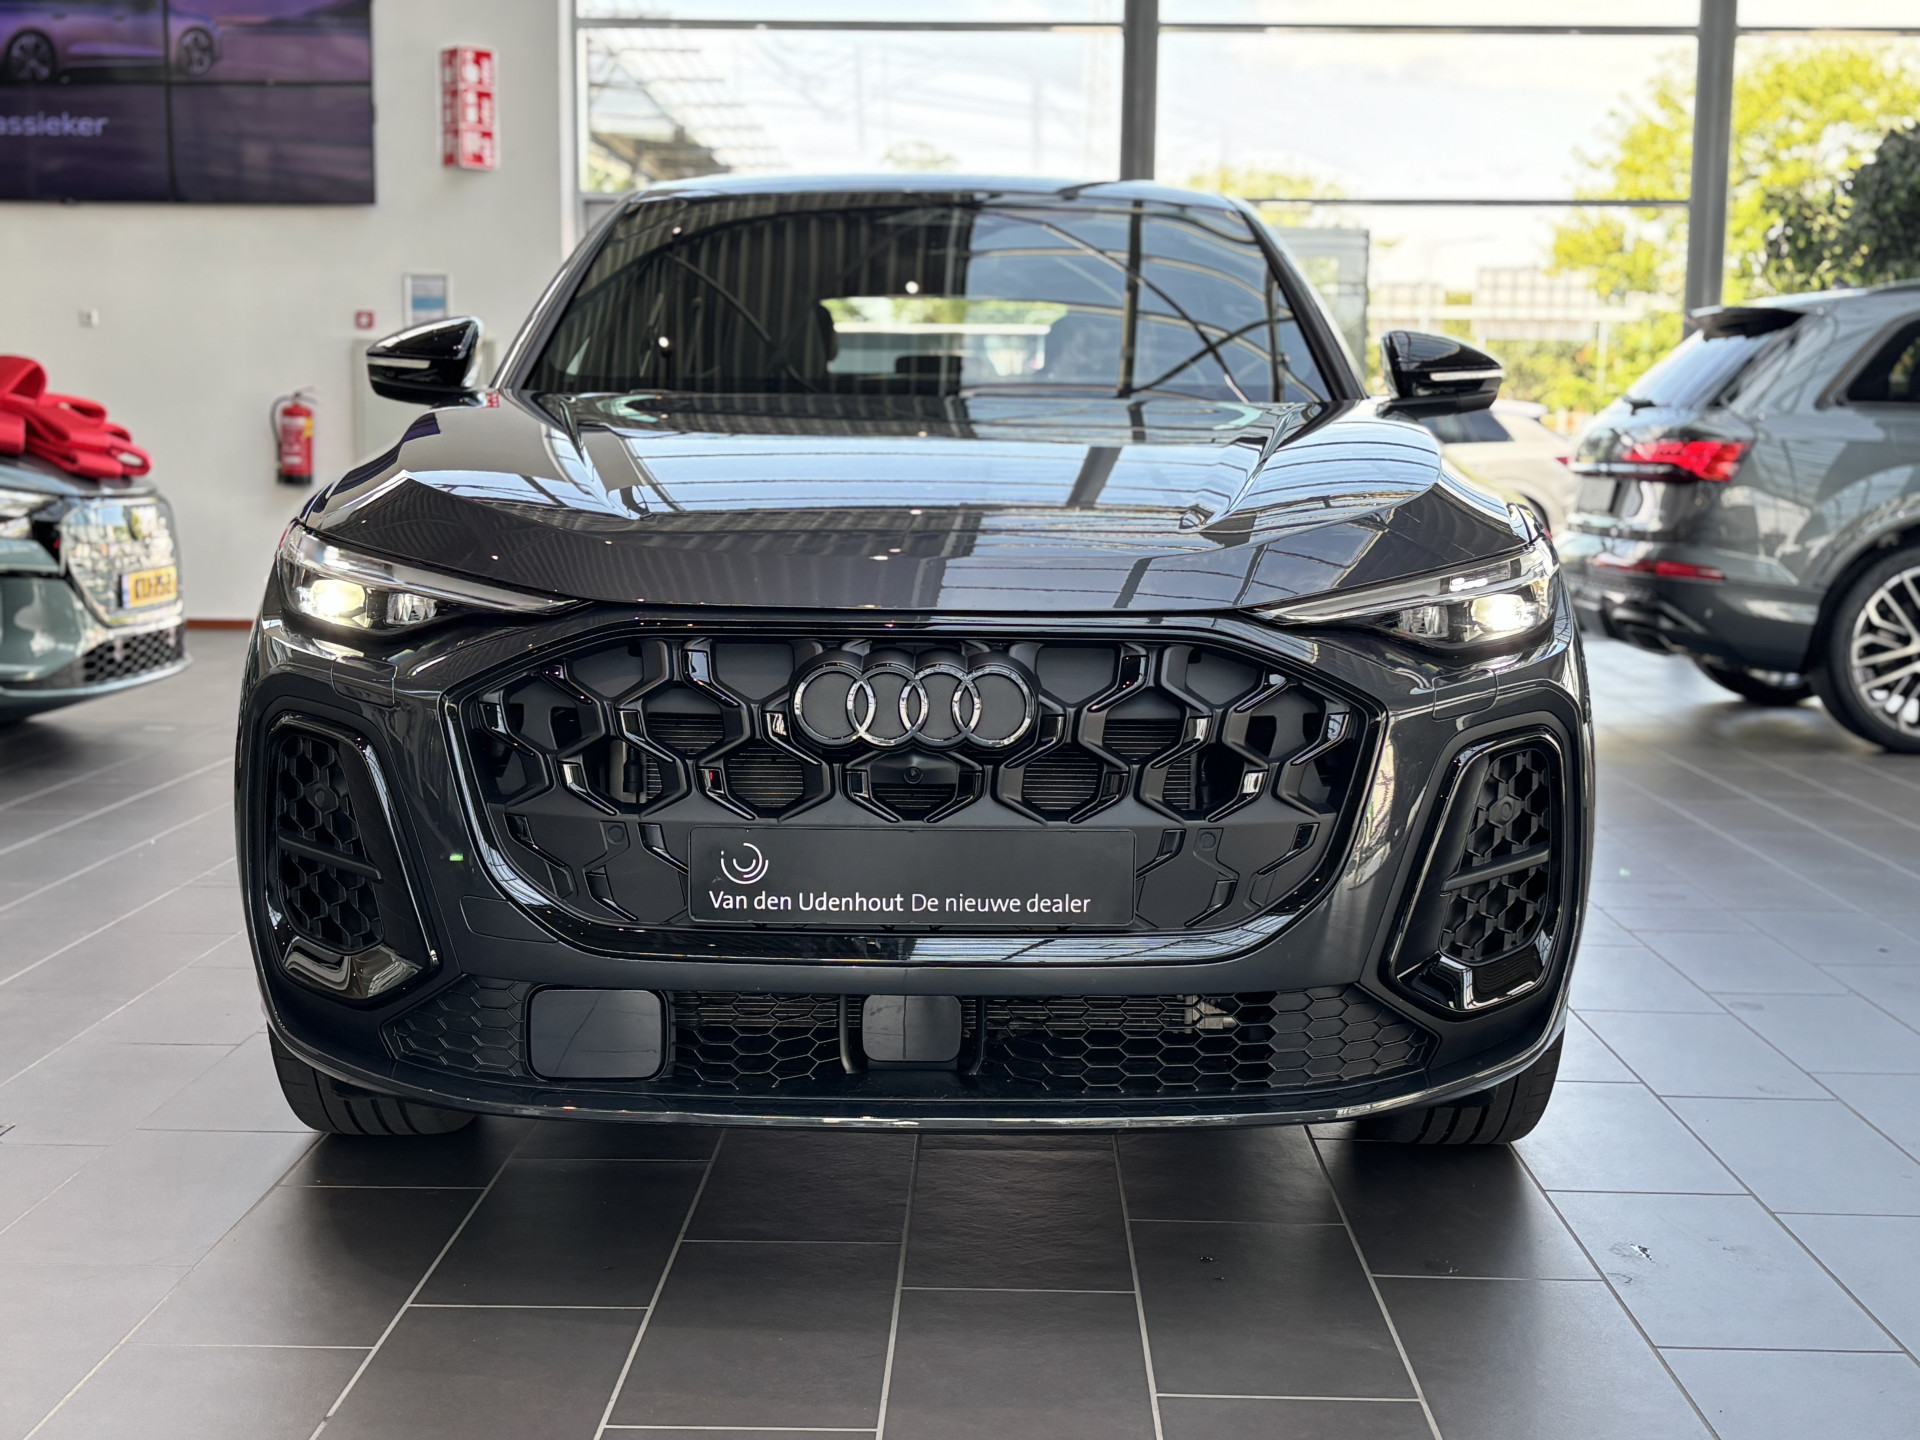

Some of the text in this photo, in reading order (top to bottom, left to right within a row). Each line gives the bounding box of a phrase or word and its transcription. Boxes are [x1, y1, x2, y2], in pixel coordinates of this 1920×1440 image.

[709, 891, 1092, 913] Van den Udenhout De nieuwe dealer
